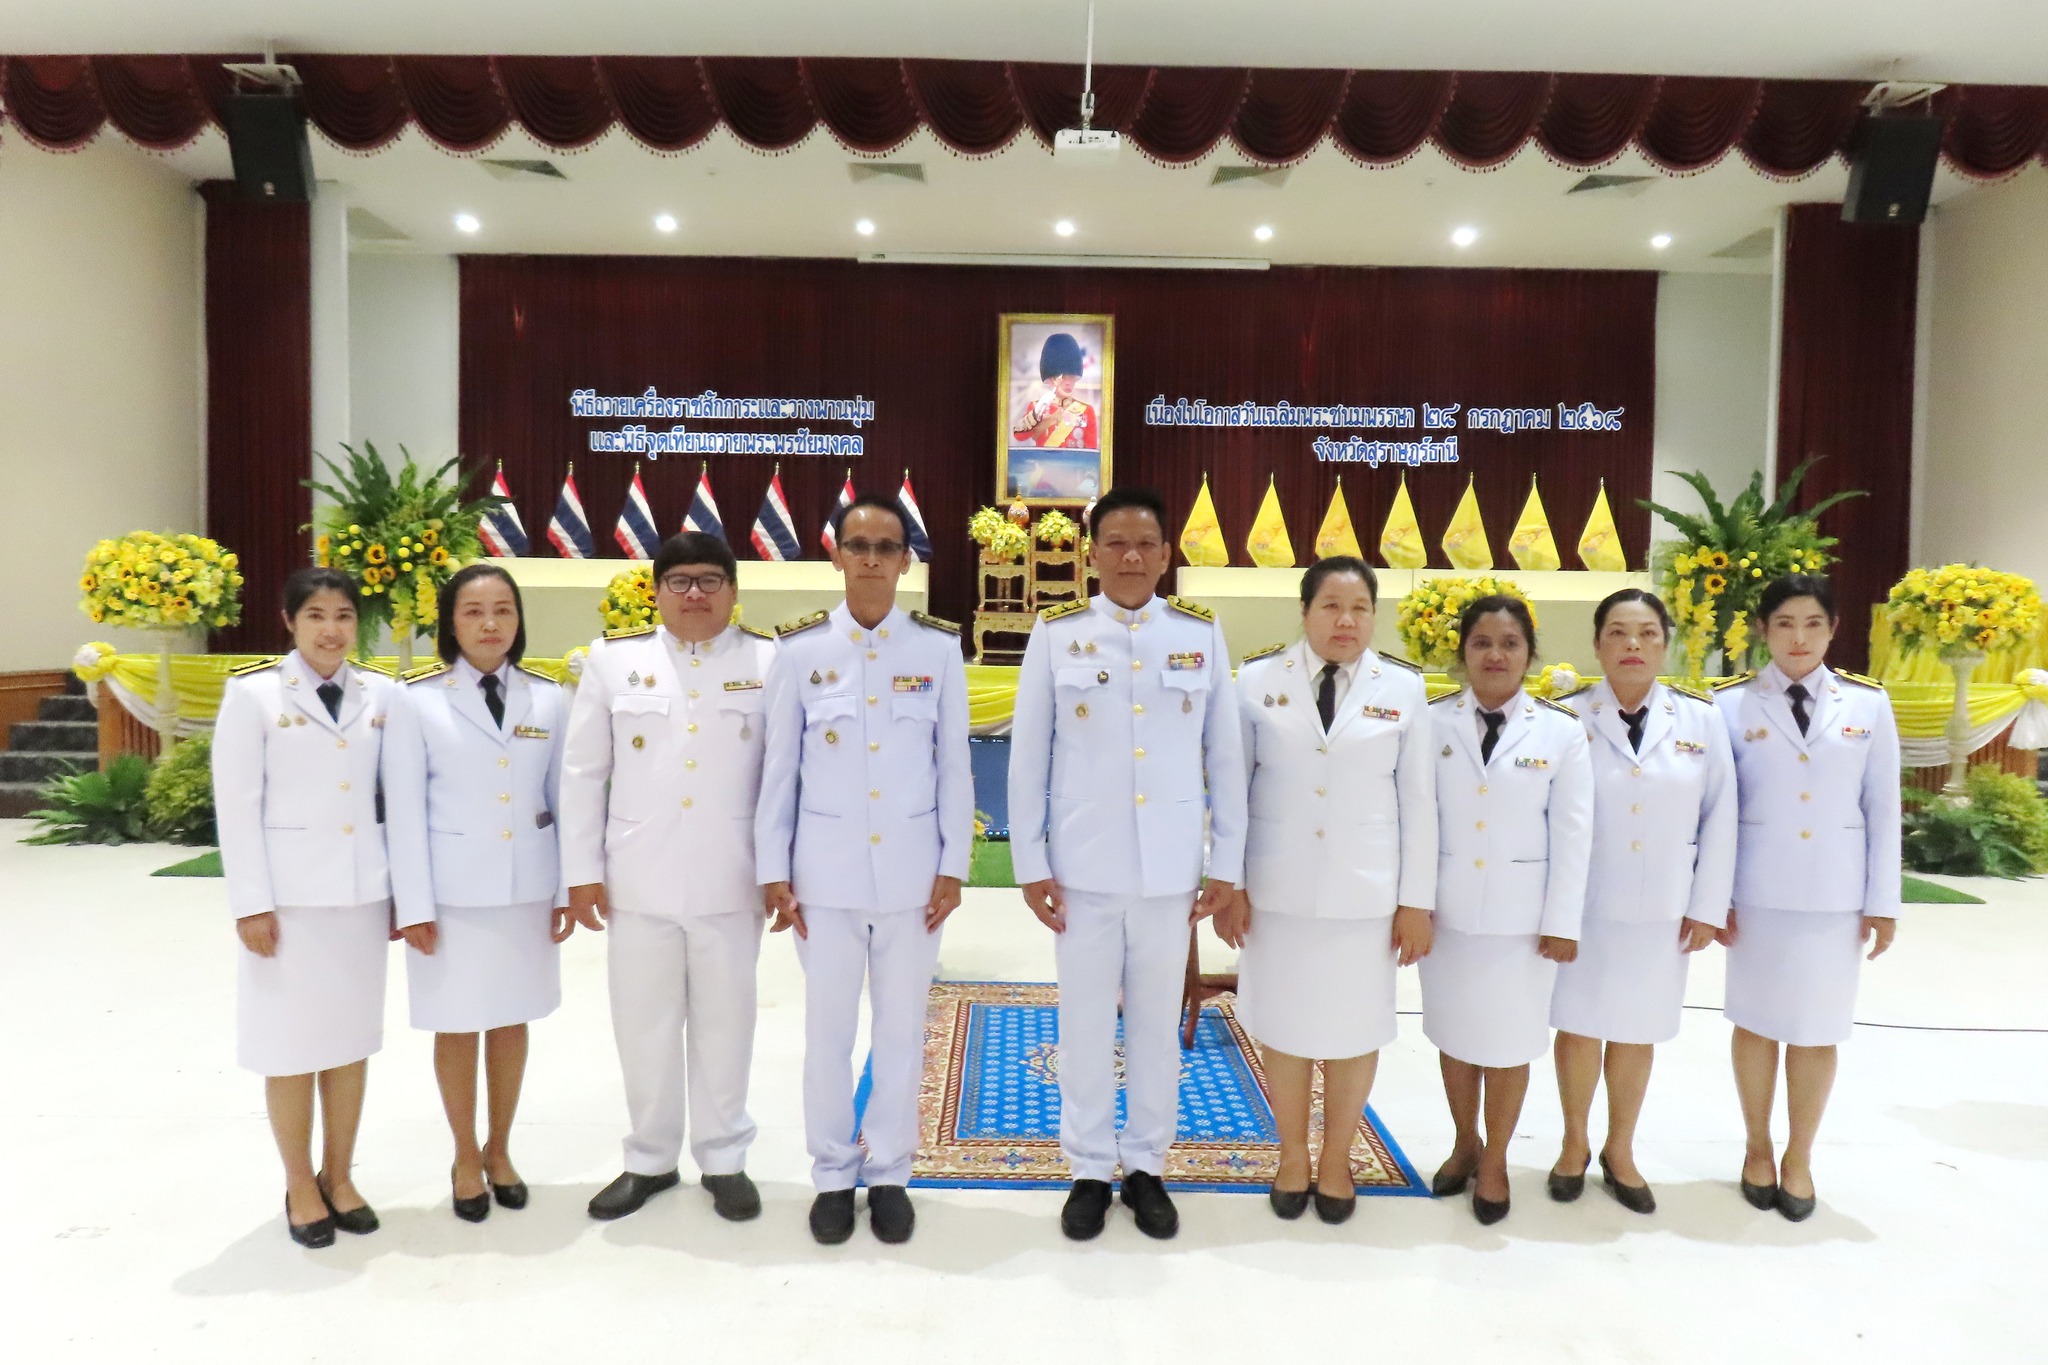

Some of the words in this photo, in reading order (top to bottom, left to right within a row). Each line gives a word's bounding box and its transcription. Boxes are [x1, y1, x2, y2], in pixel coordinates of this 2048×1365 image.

[570, 386, 874, 428] พิธีถวายเครื่องราชสักการะและวางพานพุ่ม
[1146, 394, 1415, 428] เนื่องในโอกาสวันเฉลิมพระชนมพรรษา
[1423, 402, 1461, 429] ๒๘
[1467, 408, 1551, 434] กรกฎาคม
[1558, 402, 1625, 431] ๒๕๖๘
[590, 425, 863, 461] และพิธีจุดเทียนถวายพระพรชัยมงคล
[1312, 435, 1459, 469] จังหวัดสุราษฎร์ธานี
